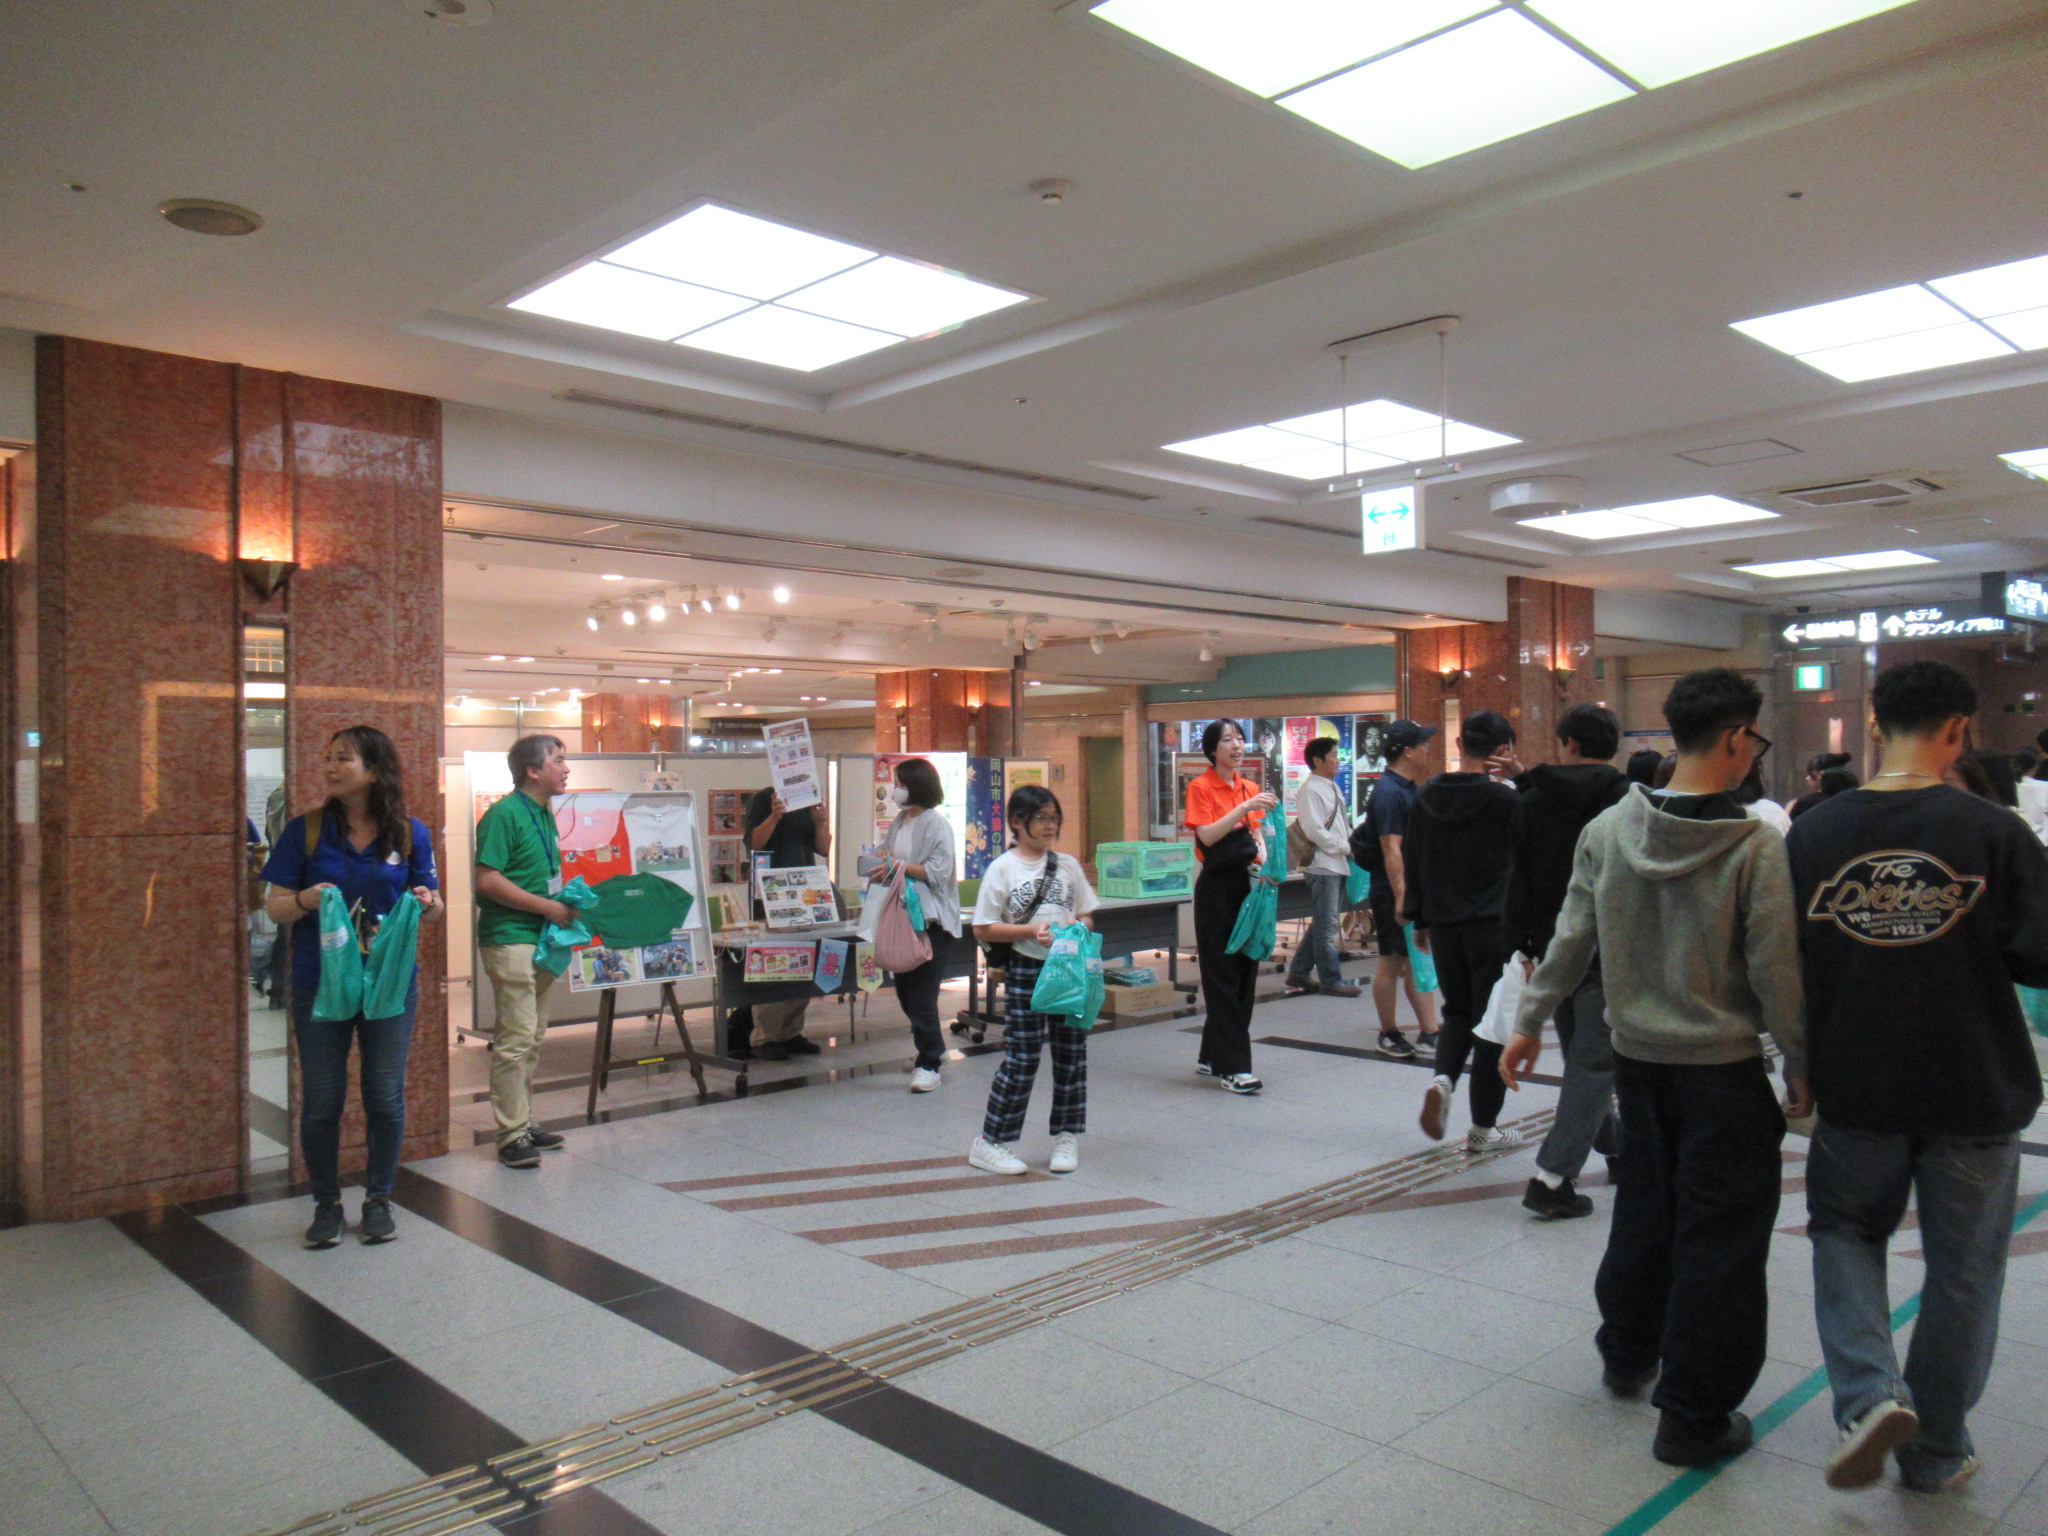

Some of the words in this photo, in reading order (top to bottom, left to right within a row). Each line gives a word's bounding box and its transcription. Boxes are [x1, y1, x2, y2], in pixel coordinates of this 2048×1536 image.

[1904, 608, 1942, 622] ホテル
[1866, 859, 1924, 881] The
[1826, 880, 1963, 912] Dickies
[1892, 924, 1926, 936] 1922
